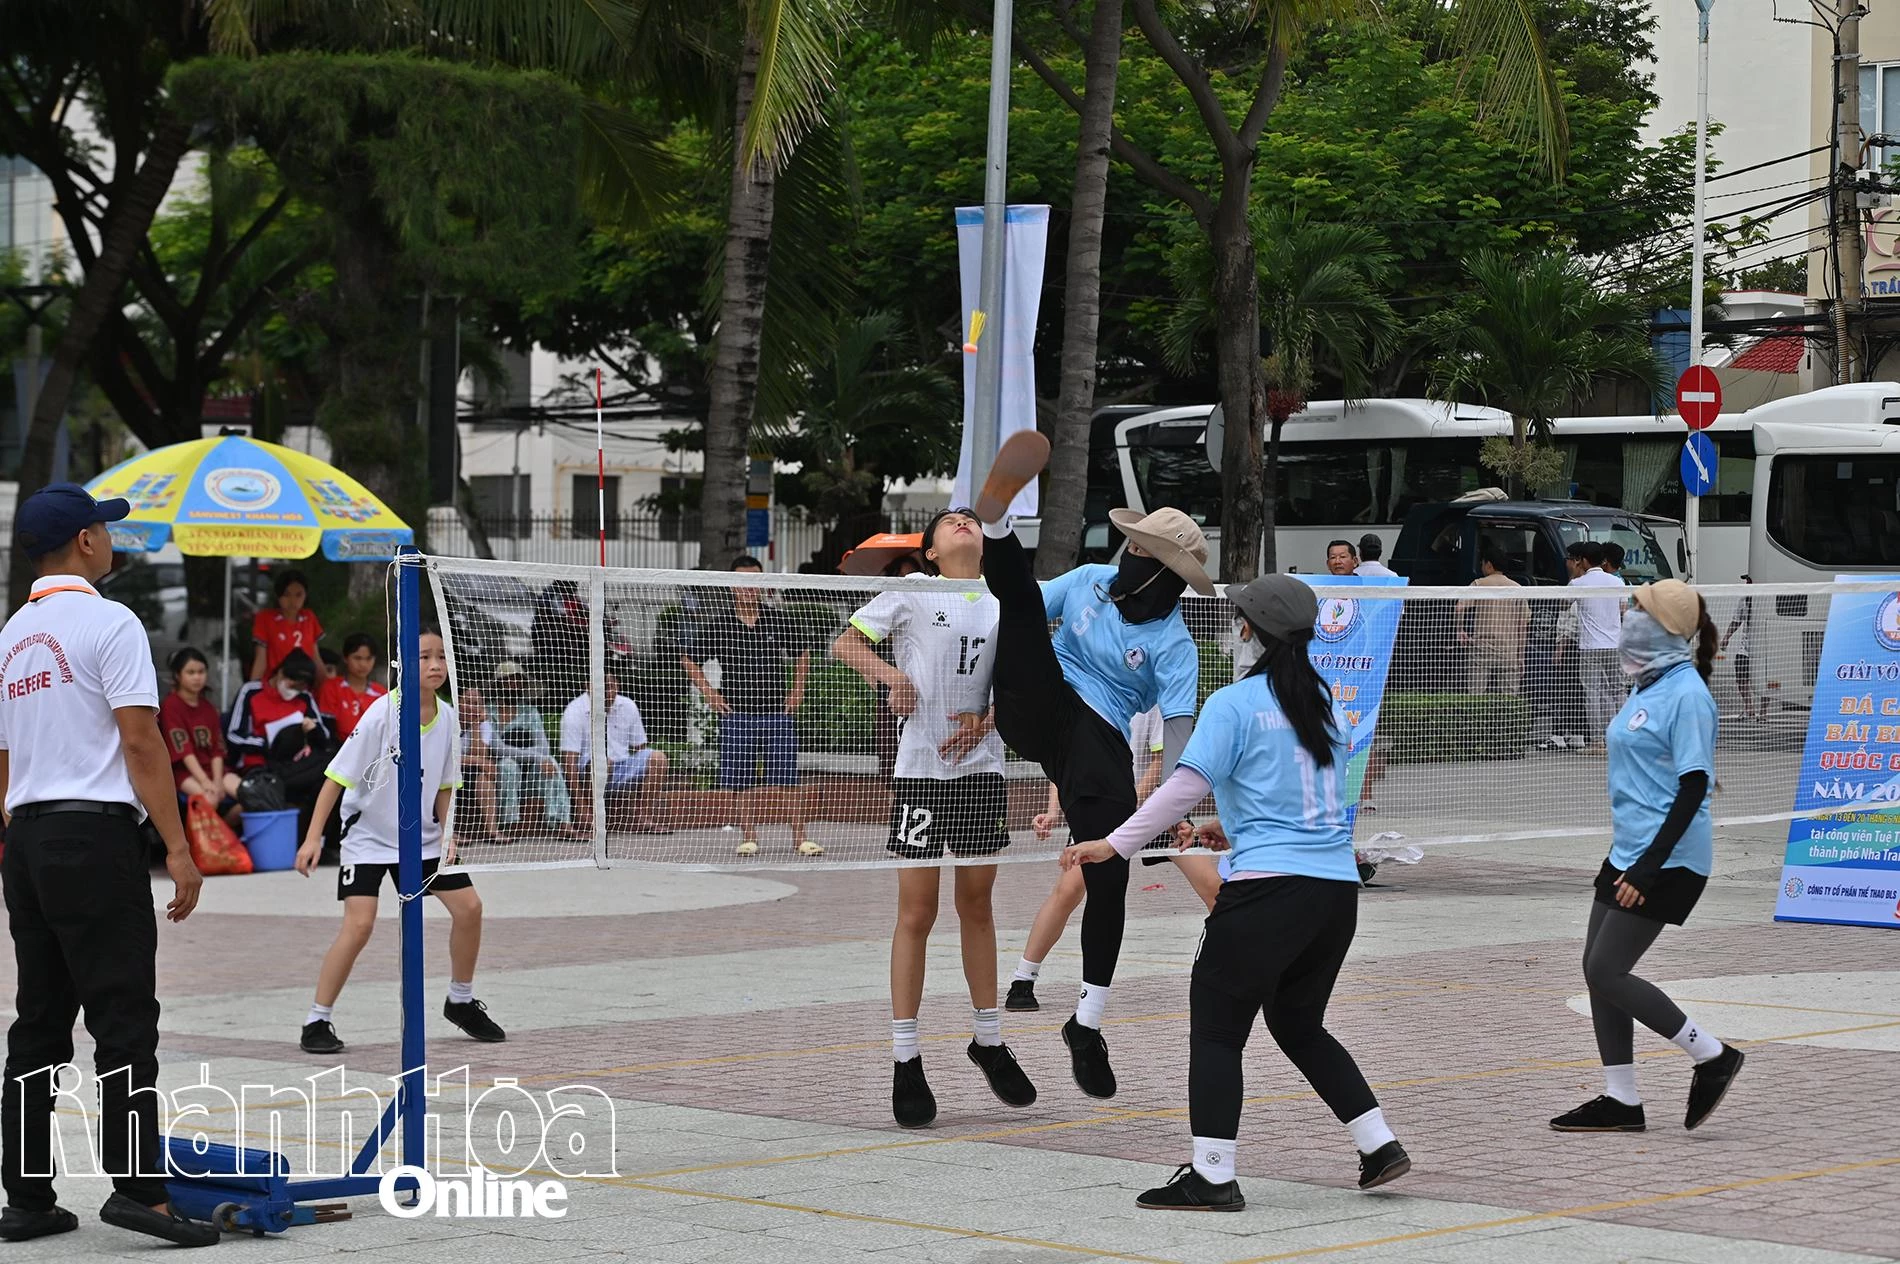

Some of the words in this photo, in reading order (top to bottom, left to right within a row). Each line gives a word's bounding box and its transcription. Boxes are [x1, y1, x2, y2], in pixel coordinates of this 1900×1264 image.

[1071, 605, 1099, 637] 5
[293, 631, 303, 647] 2
[1334, 655, 1374, 675] ĐỊCH
[1836, 659, 1872, 680] GIẢI
[1839, 692, 1873, 715] ĐÁ
[1881, 697, 1900, 716] C
[1824, 720, 1871, 742] BÃI
[1820, 744, 1883, 770] QUỐC
[1813, 777, 1865, 799] NĂM
[897, 803, 931, 848] 12
[1811, 827, 1824, 843] tại
[1826, 828, 1850, 844] công
[1851, 829, 1872, 843] viên
[1875, 830, 1892, 846] Tuệ
[1809, 845, 1838, 858] thành
[1839, 846, 1861, 862] phố
[1861, 847, 1881, 861] Nha
[1807, 884, 1823, 895] CÔNG
[1824, 886, 1831, 896] TY
[1870, 889, 1885, 899] THAO
